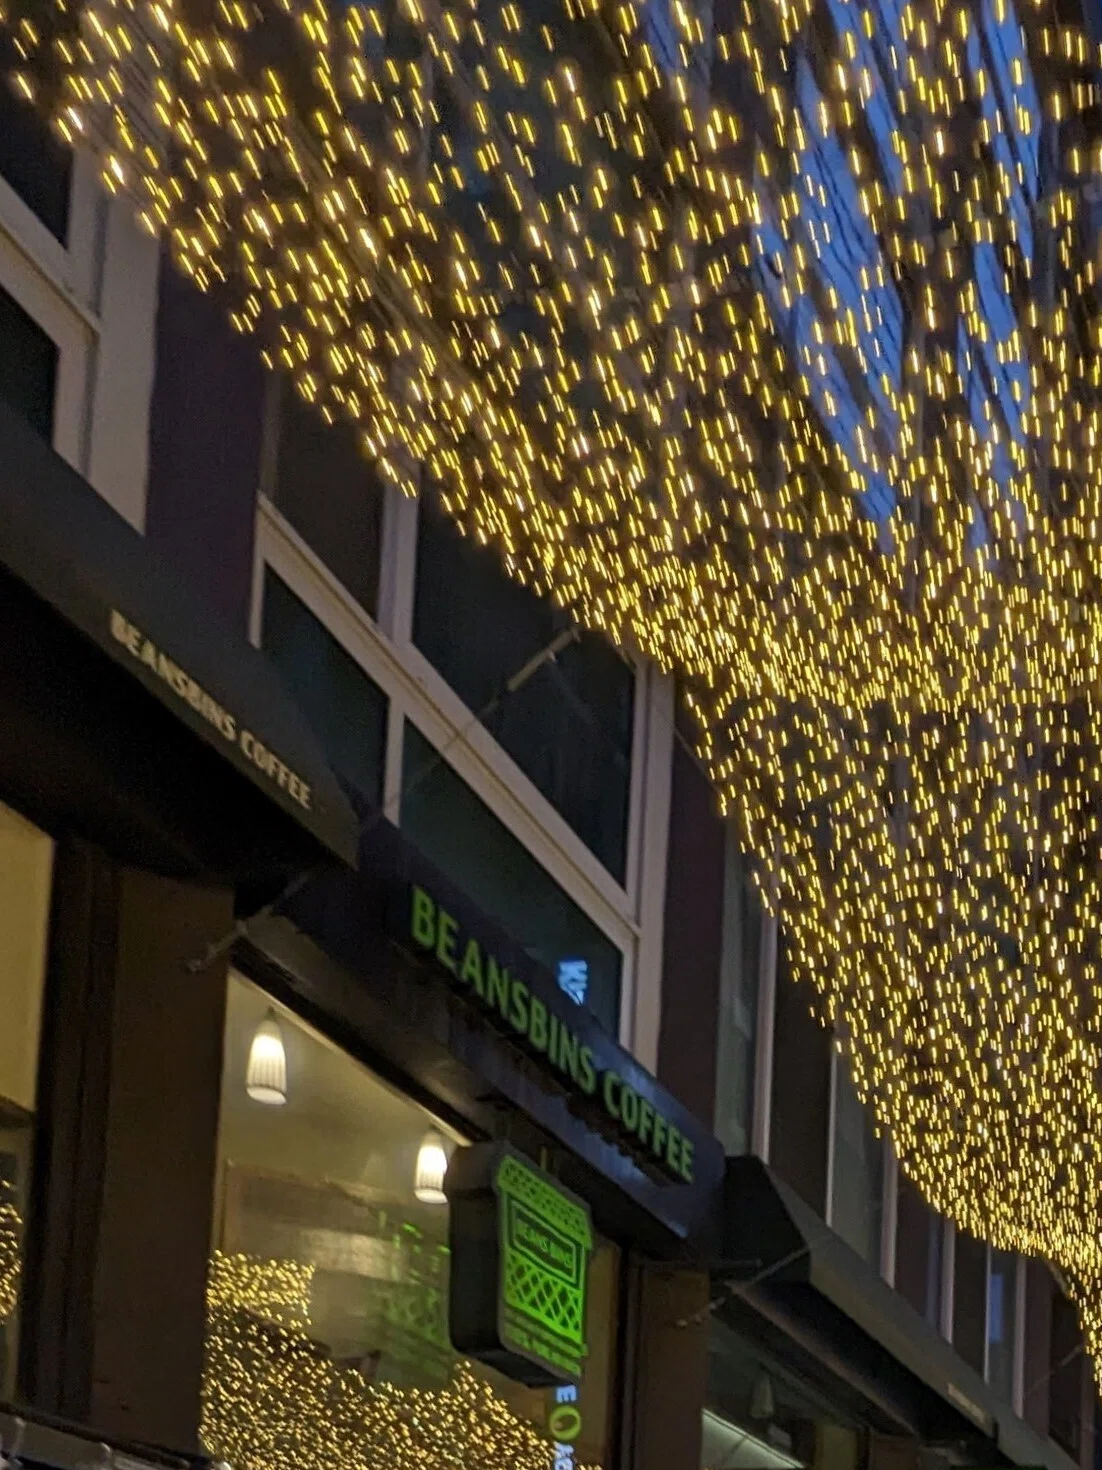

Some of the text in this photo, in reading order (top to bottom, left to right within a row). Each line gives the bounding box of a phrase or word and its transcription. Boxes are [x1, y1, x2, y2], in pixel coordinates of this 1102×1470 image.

[110, 608, 312, 809] BEANSBINS COFFEE
[411, 885, 694, 1183] BEANSBINS COFFEE
